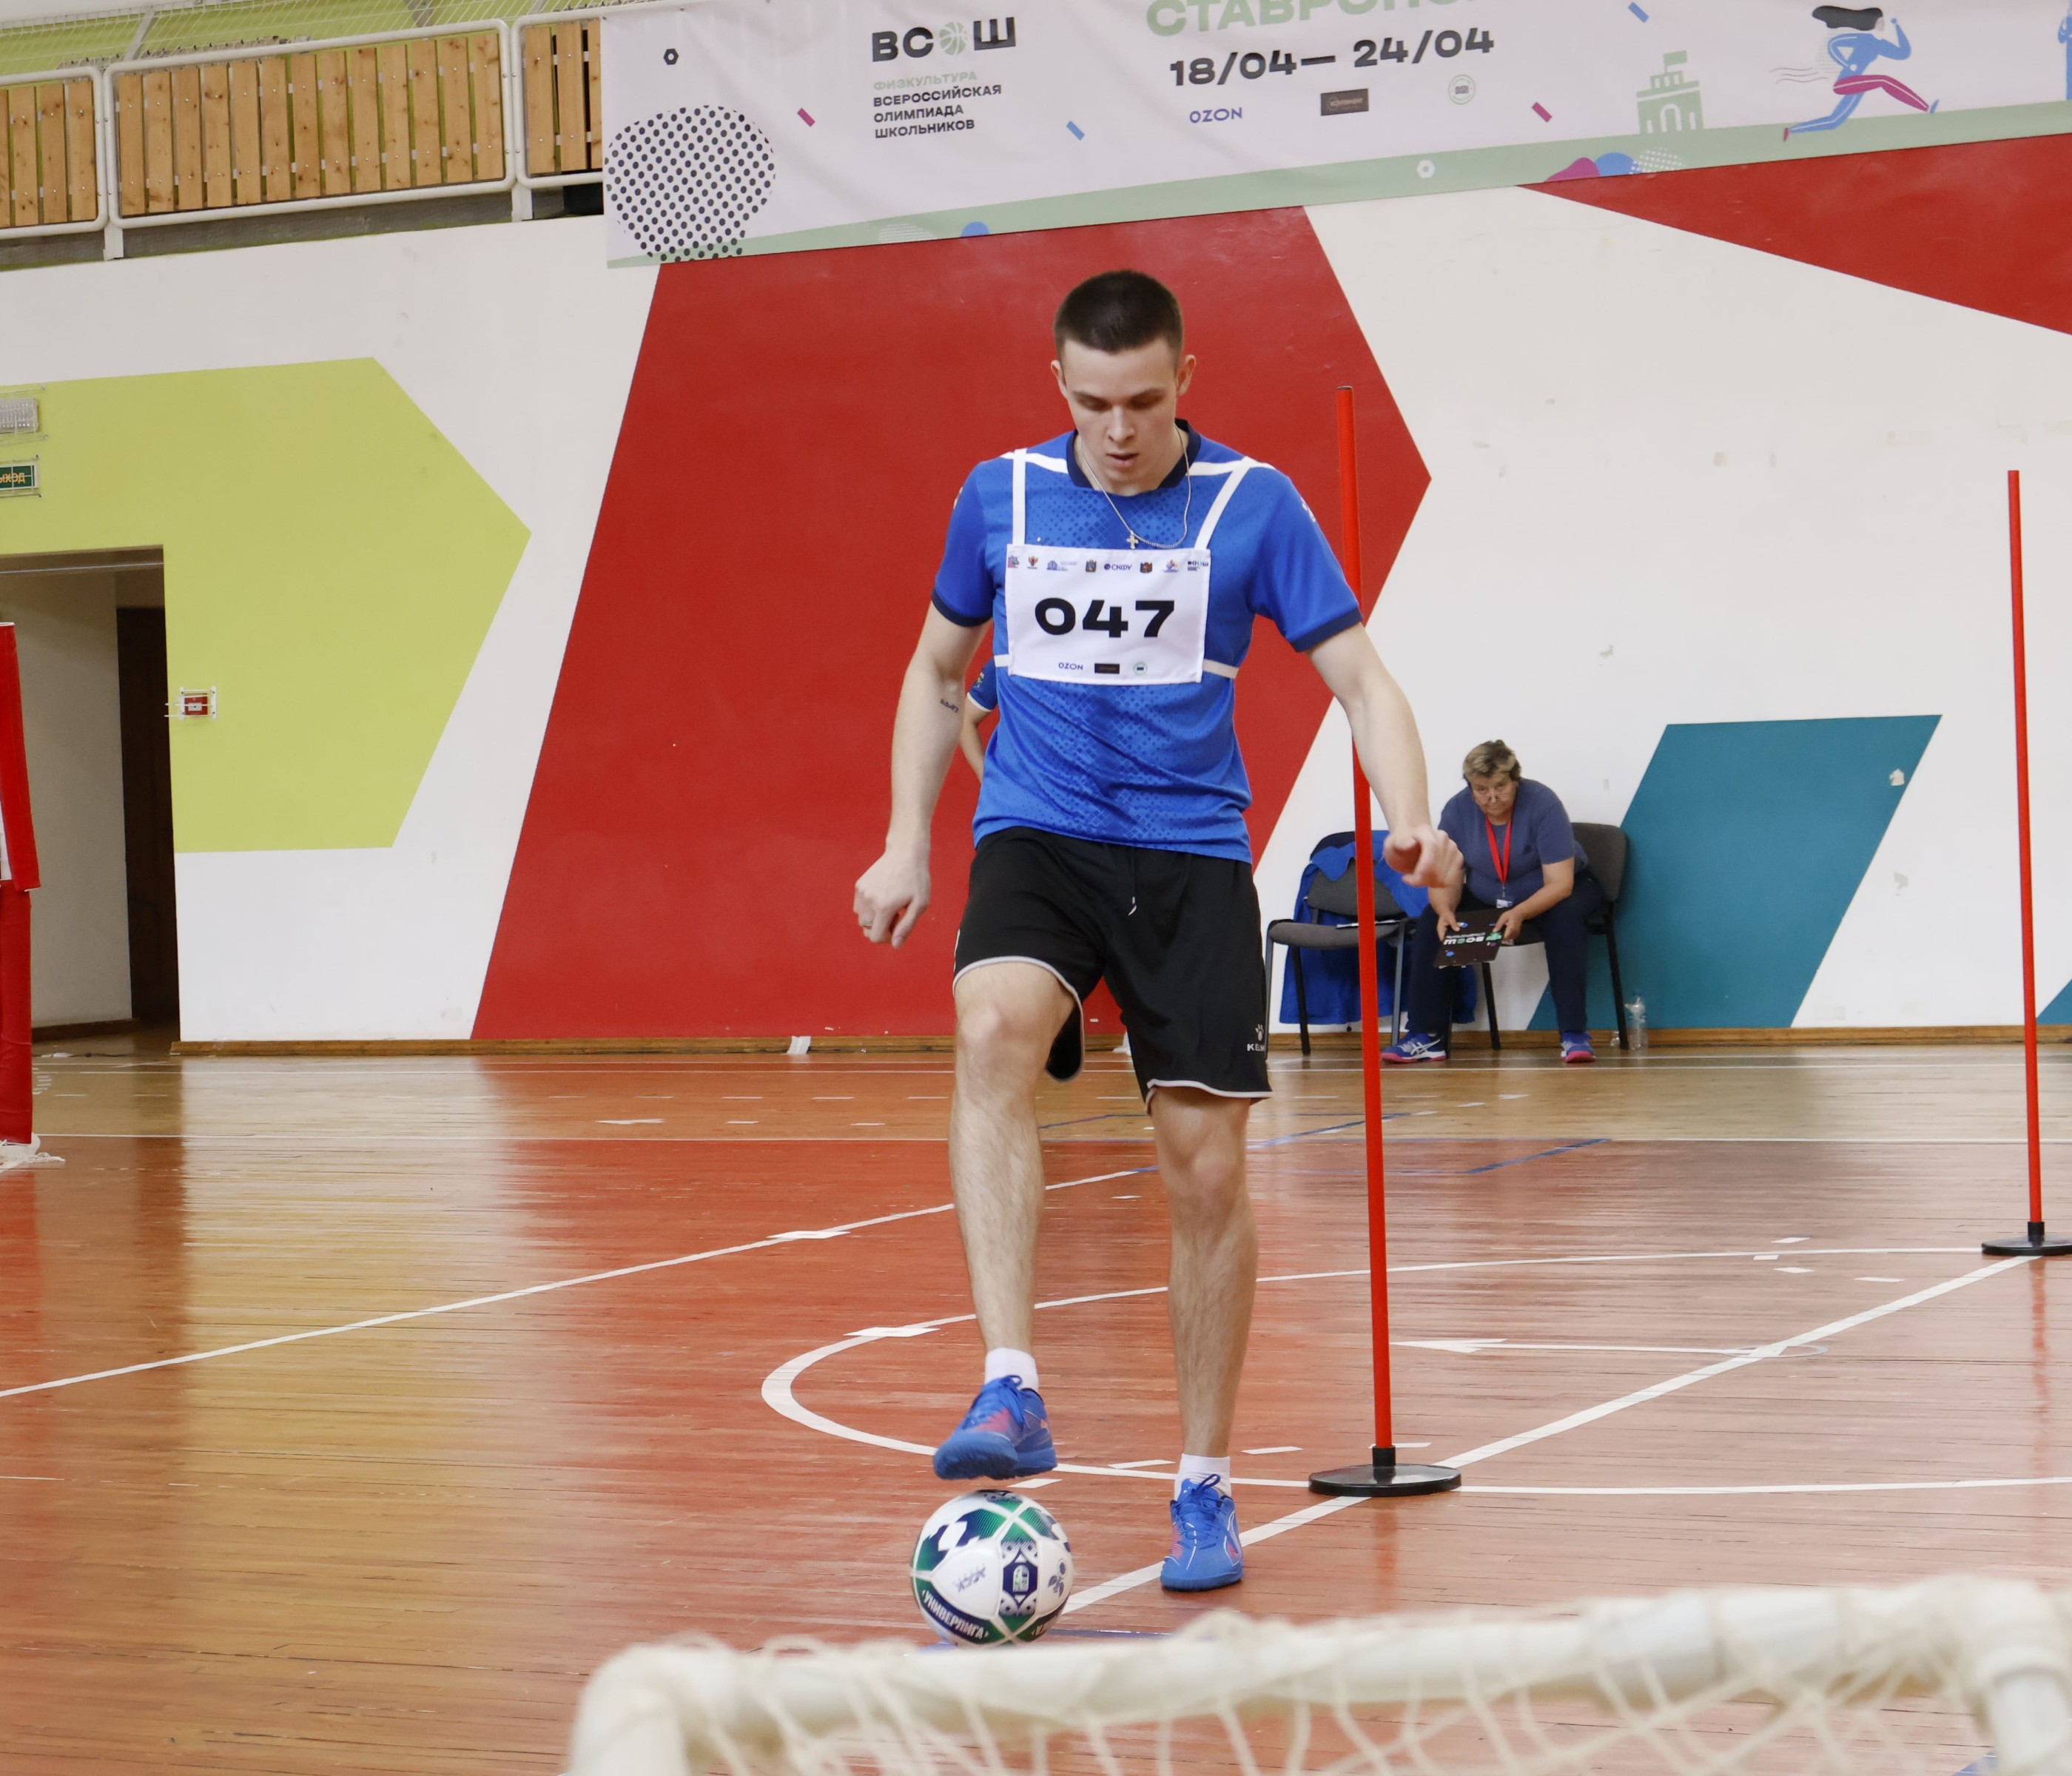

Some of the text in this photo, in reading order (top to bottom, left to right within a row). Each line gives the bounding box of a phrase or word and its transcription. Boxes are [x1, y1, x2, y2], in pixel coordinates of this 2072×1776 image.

[1146, 0, 1476, 36] СТАВР
[1353, 27, 1495, 68] 24/04
[873, 72, 978, 90] ФИЗКУЛЬТУРА
[873, 84, 1001, 107] ВСЕРОССИЙСКАЯ
[874, 104, 963, 123] ОЛИМПИАДА
[1189, 107, 1242, 124] OZON
[875, 119, 975, 138] ШКОЛЬНИКОВ
[1035, 597, 1175, 638] 047
[1058, 662, 1083, 670] OZON
